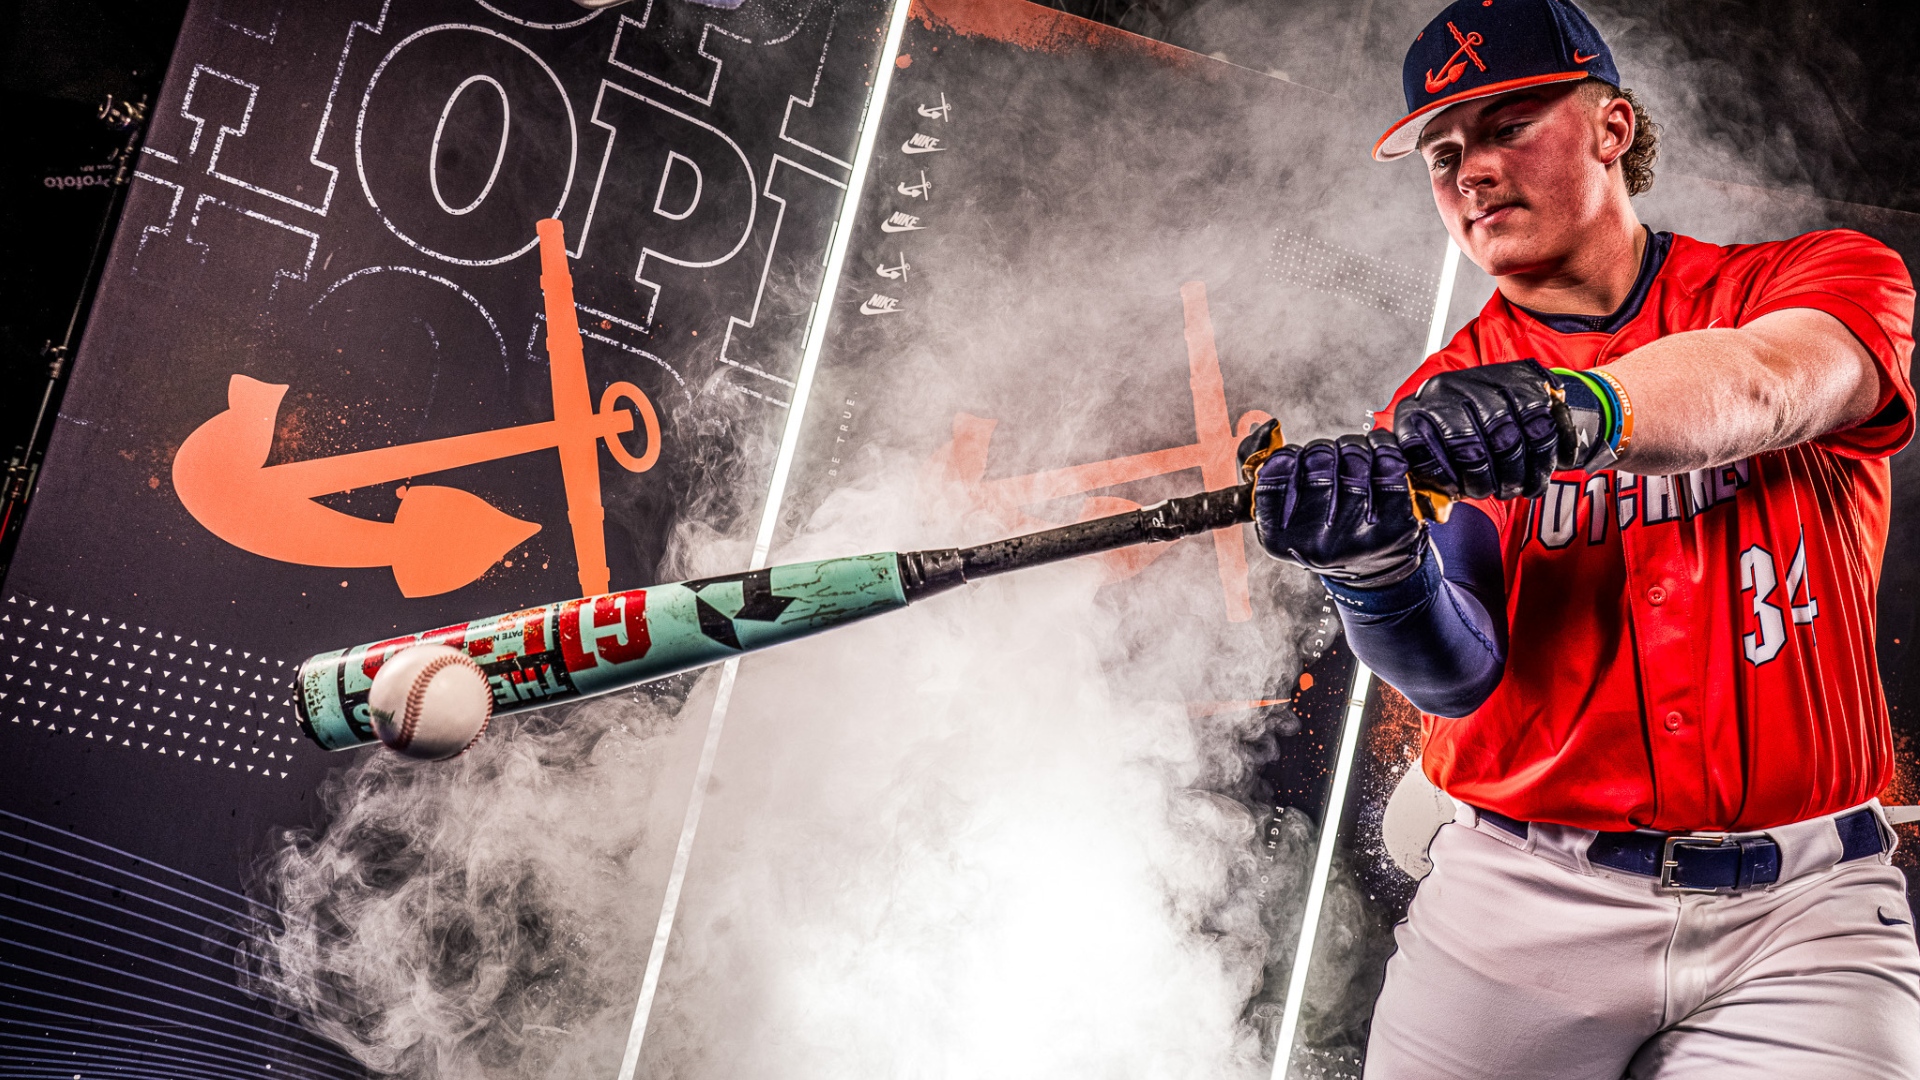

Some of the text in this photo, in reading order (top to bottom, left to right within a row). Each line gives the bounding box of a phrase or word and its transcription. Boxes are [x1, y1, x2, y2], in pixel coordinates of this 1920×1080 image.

[909, 132, 940, 149] NIKE
[889, 211, 920, 228] NIKE
[868, 293, 899, 310] NIKE
[828, 391, 858, 477] BE TRUE.
[1739, 523, 1819, 668] 34
[1312, 594, 1334, 659] LETICS
[488, 663, 567, 706] THE
[1266, 806, 1284, 862] FIGHT
